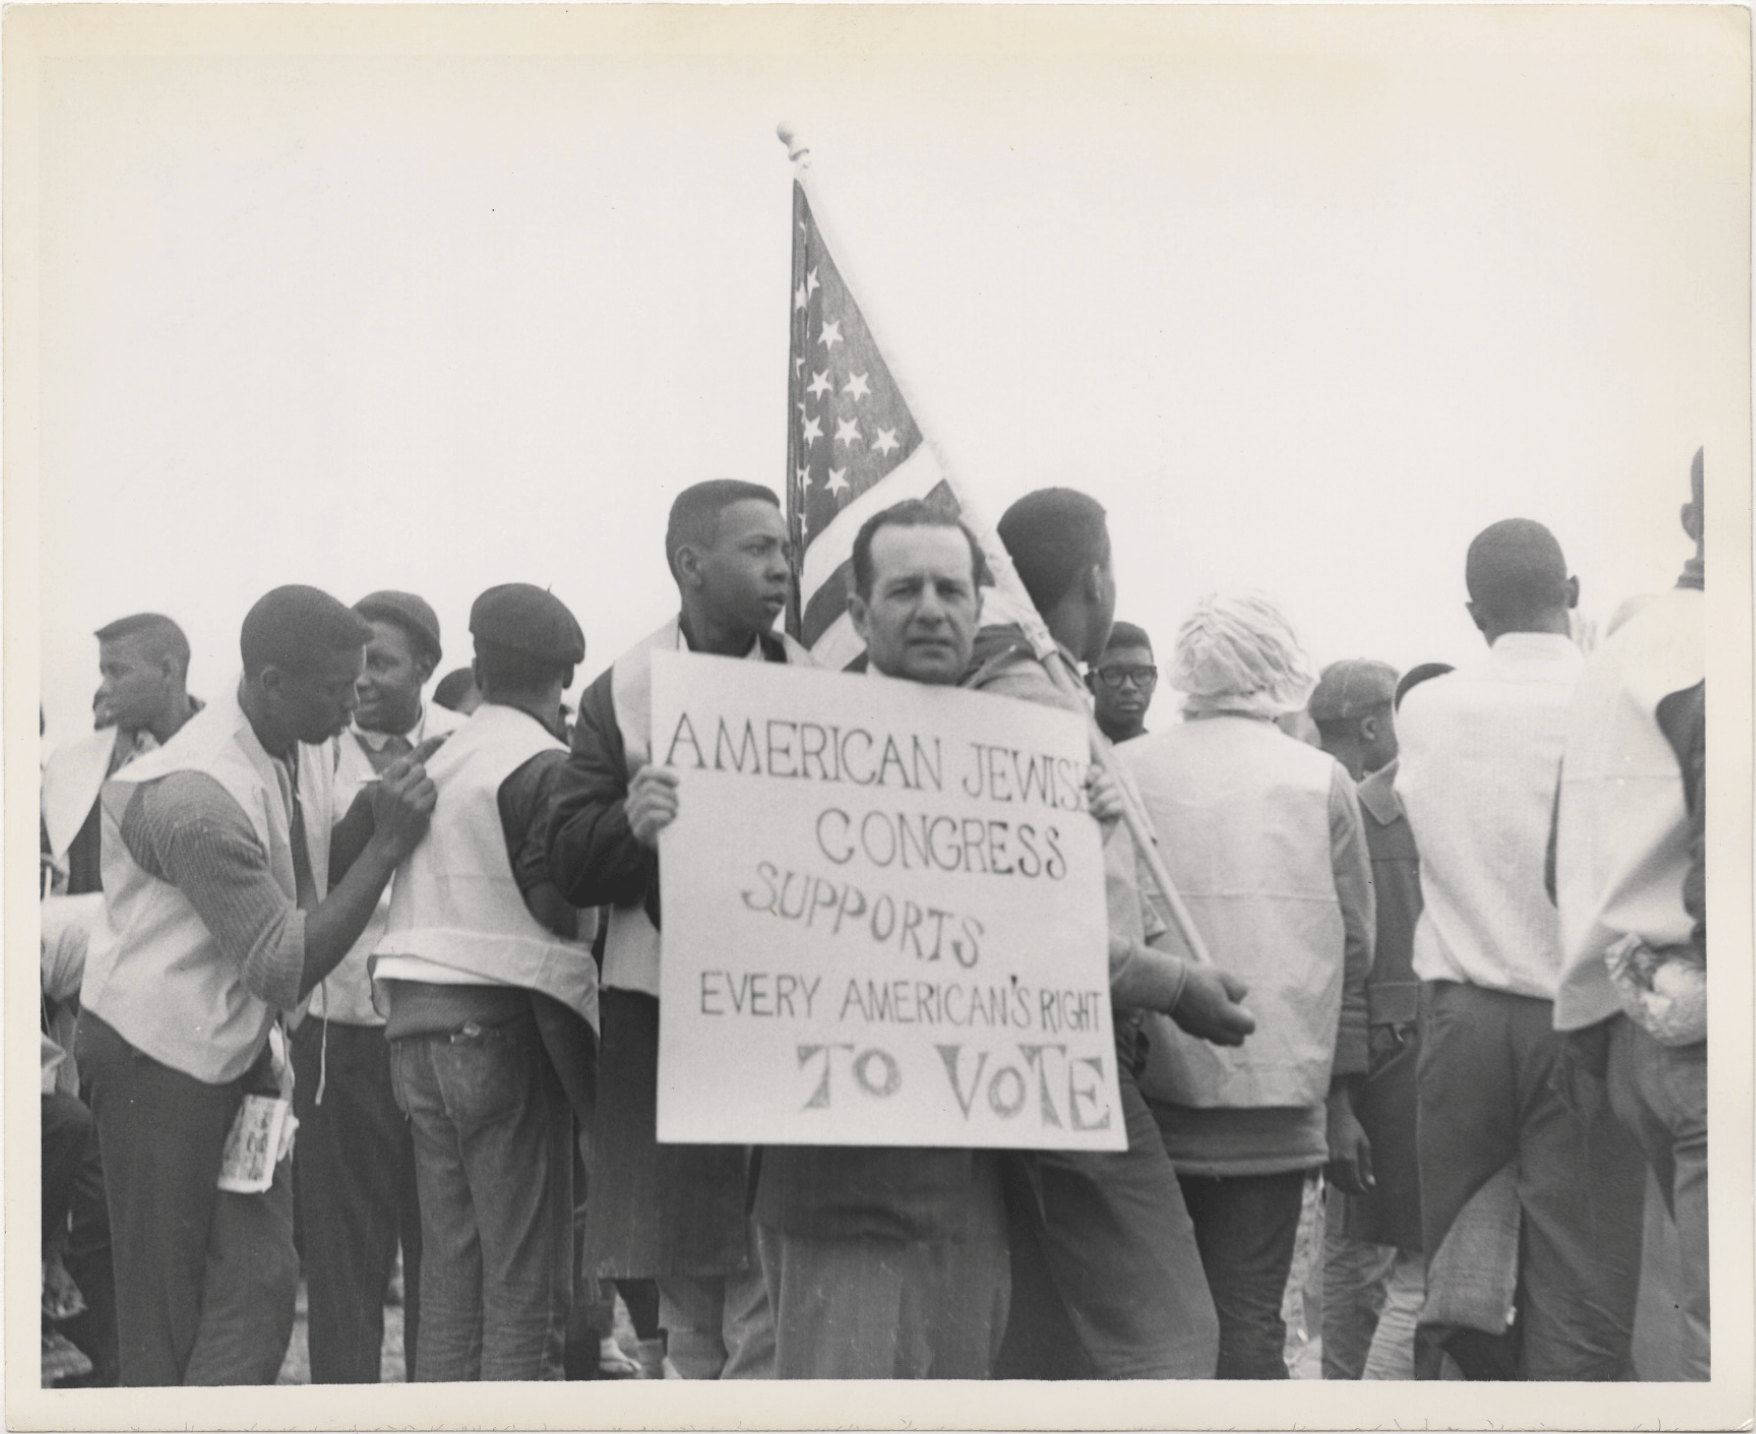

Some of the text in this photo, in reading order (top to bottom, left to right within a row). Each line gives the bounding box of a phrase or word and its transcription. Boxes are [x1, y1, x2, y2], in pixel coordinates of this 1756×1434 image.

[665, 711, 943, 792] AMERICAN
[816, 807, 1067, 880] CONGRESS
[741, 861, 985, 968] SUPPORTS
[701, 970, 1103, 1034] EVERY AMERICAN'S RIGHT
[797, 1043, 902, 1110] TO
